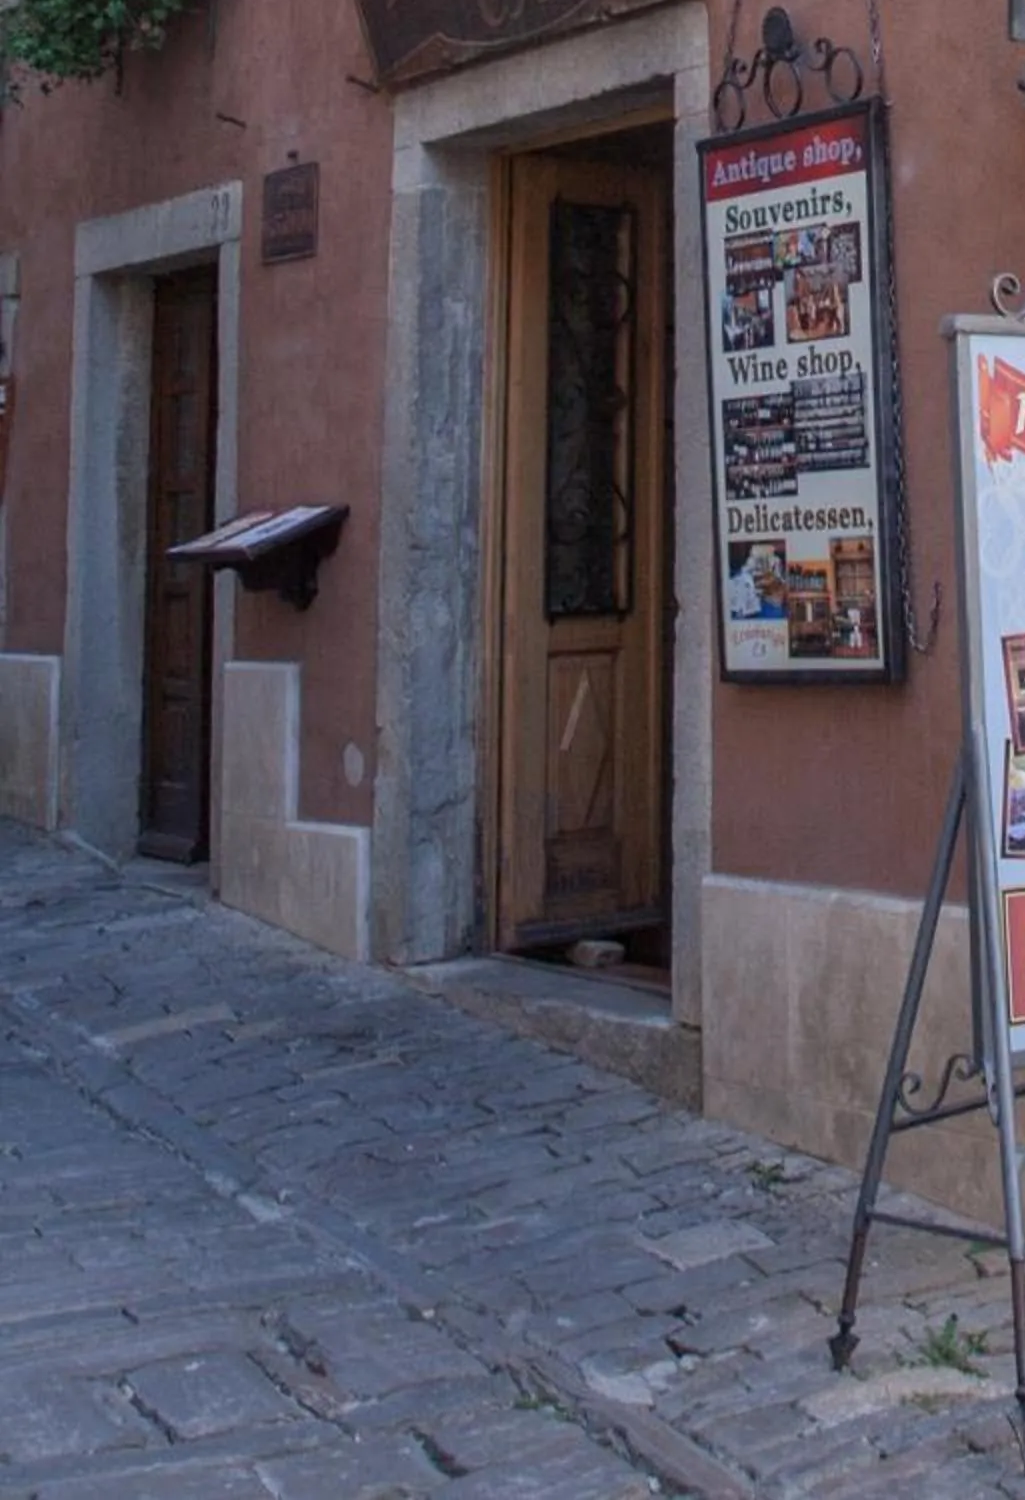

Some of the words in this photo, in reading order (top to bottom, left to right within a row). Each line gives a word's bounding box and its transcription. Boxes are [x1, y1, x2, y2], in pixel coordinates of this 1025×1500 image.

[713, 149, 797, 186] Antique
[803, 135, 862, 167] shop,
[725, 188, 852, 233] Souvenirs,
[727, 355, 788, 385] Wine
